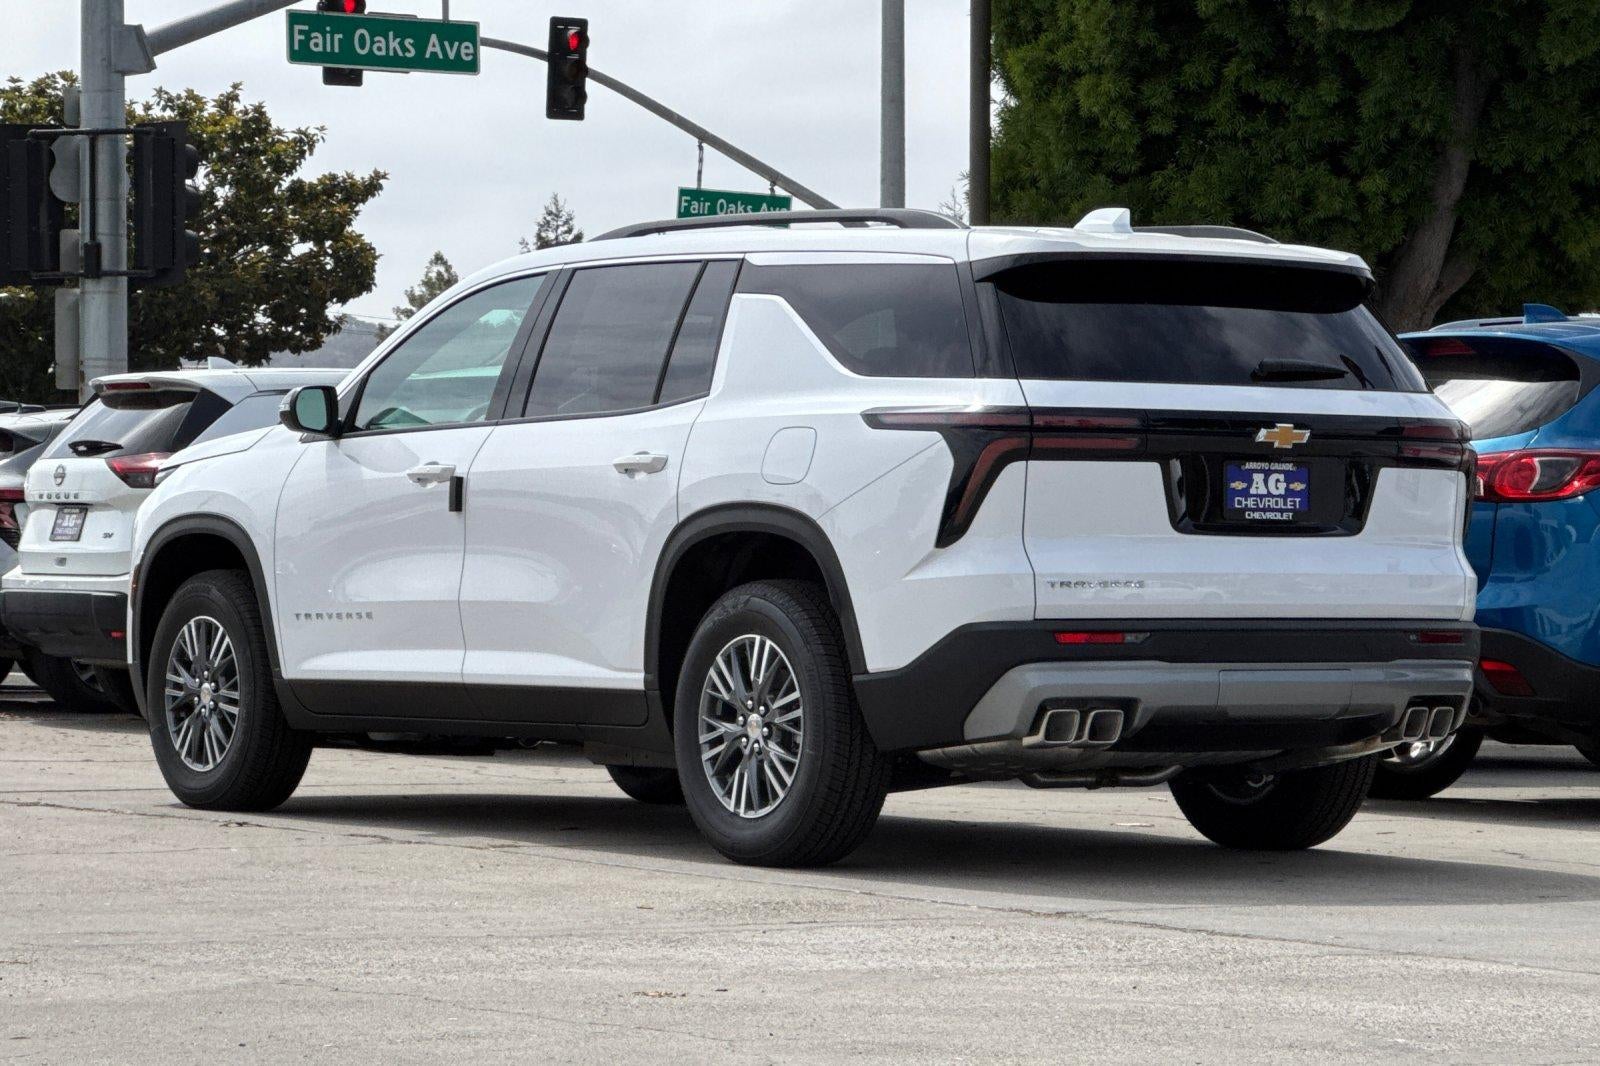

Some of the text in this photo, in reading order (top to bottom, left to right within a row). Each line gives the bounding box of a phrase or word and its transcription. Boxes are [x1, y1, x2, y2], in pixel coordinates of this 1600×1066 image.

[292, 24, 475, 61] Fair Oaks Ave
[680, 196, 710, 214] Fair
[716, 198, 753, 215] Oaks
[1245, 462, 1294, 471] ARROYO GRANDE
[1249, 472, 1287, 495] AG
[1234, 497, 1301, 509] CHEVROLET
[1245, 511, 1294, 520] CHEVROLET
[294, 611, 374, 620] TRAVERSE
